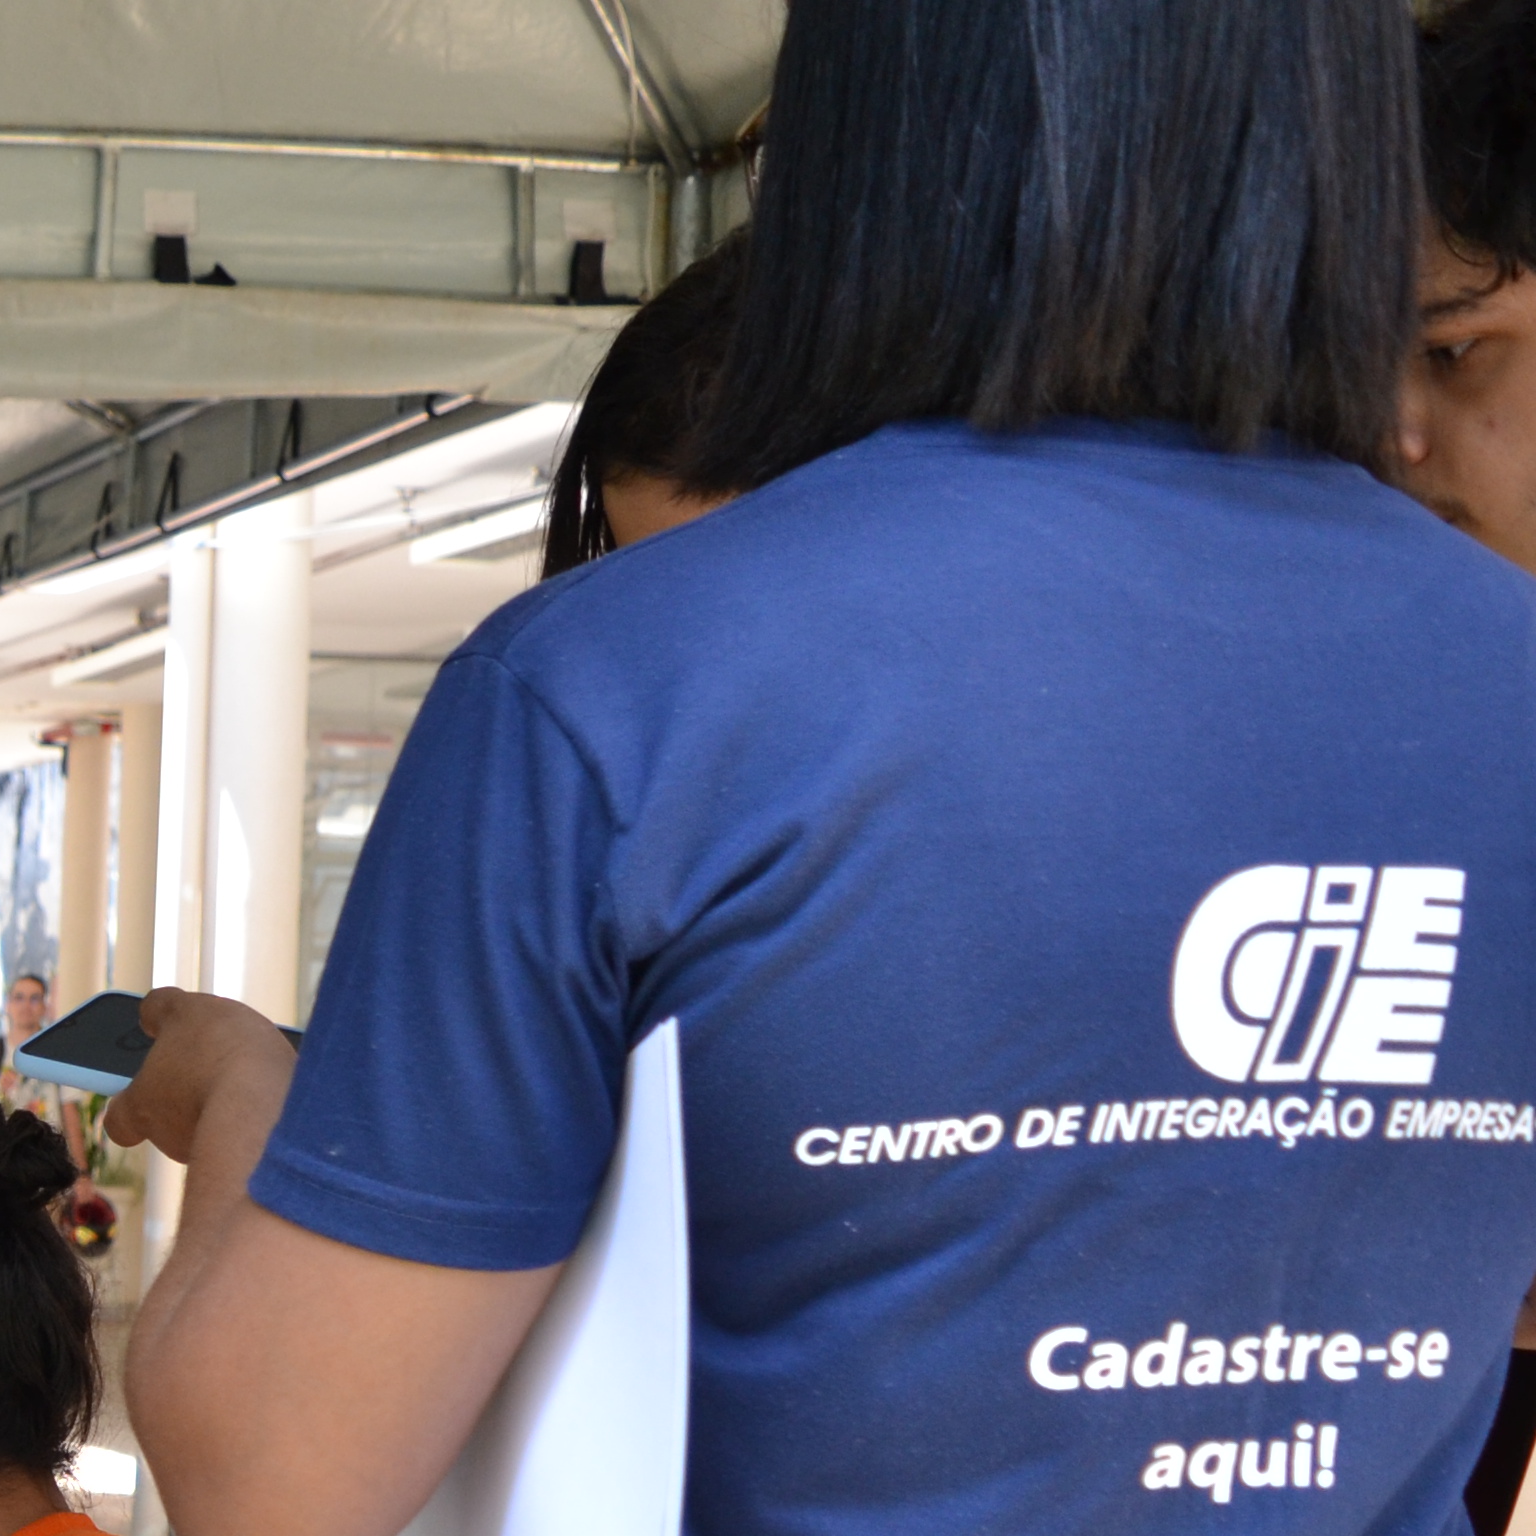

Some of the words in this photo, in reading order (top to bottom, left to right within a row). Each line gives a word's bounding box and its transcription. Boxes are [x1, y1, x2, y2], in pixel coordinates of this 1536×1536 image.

[794, 1114, 1004, 1166] CENTRO
[1015, 1106, 1084, 1149] DE
[1089, 1088, 1374, 1148] INTEGRAÇÃO
[1028, 1322, 1449, 1391] Cadastre-se
[1142, 1423, 1338, 1503] aqui!
